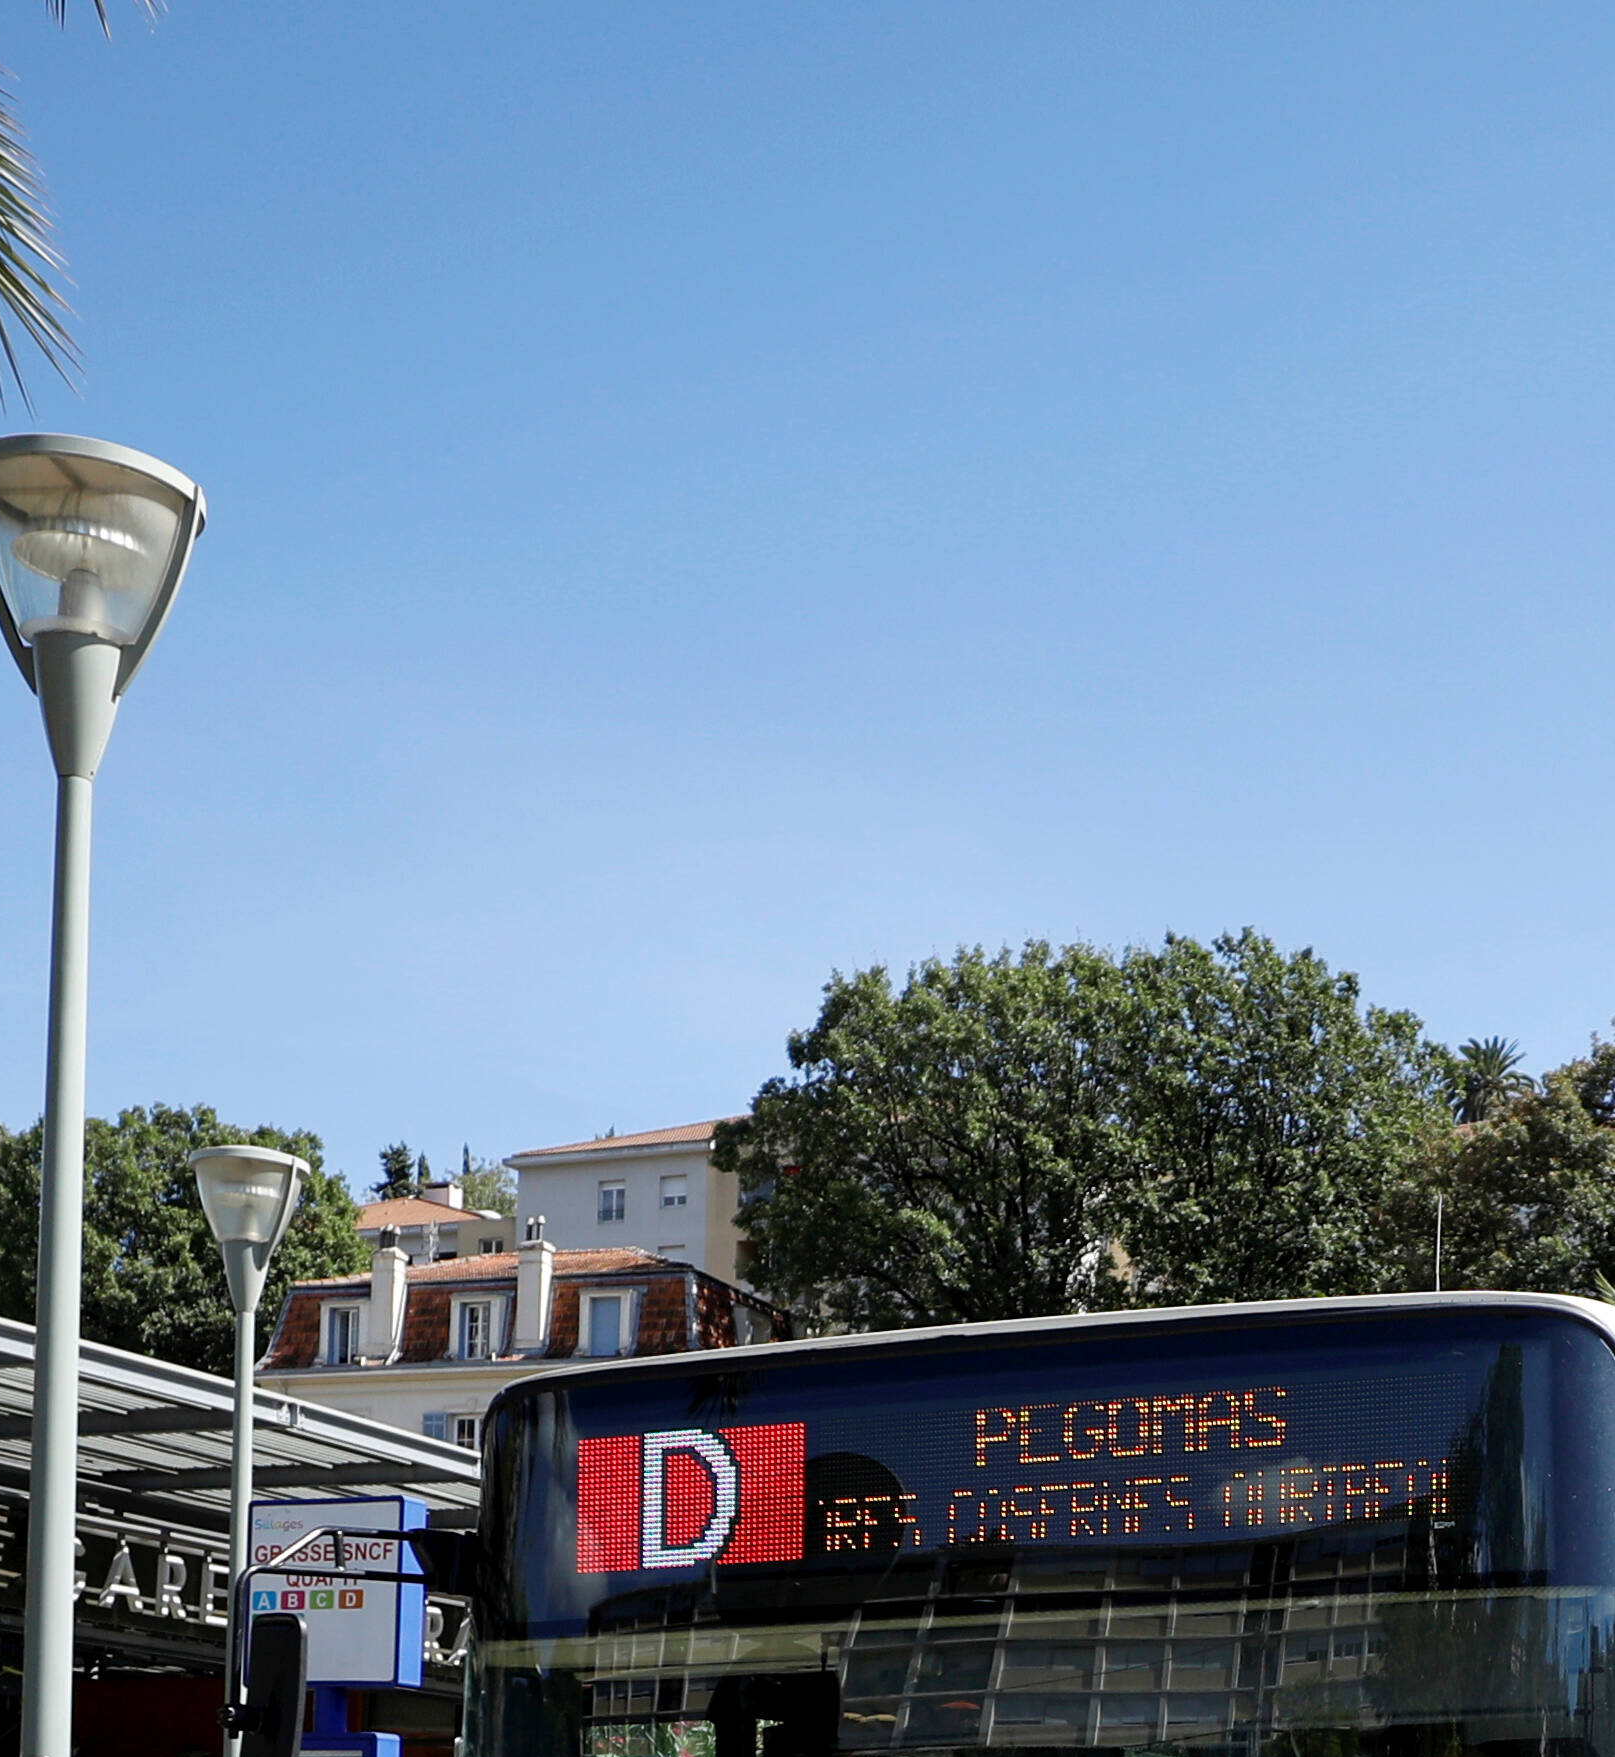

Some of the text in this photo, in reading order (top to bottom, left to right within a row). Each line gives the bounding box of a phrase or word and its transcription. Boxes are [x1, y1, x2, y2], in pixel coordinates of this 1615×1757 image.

[975, 1386, 1287, 1467] PEGOMAS
[641, 1428, 741, 1569] D
[254, 1518, 304, 1532] Sillages
[343, 1541, 394, 1562] SNCF
